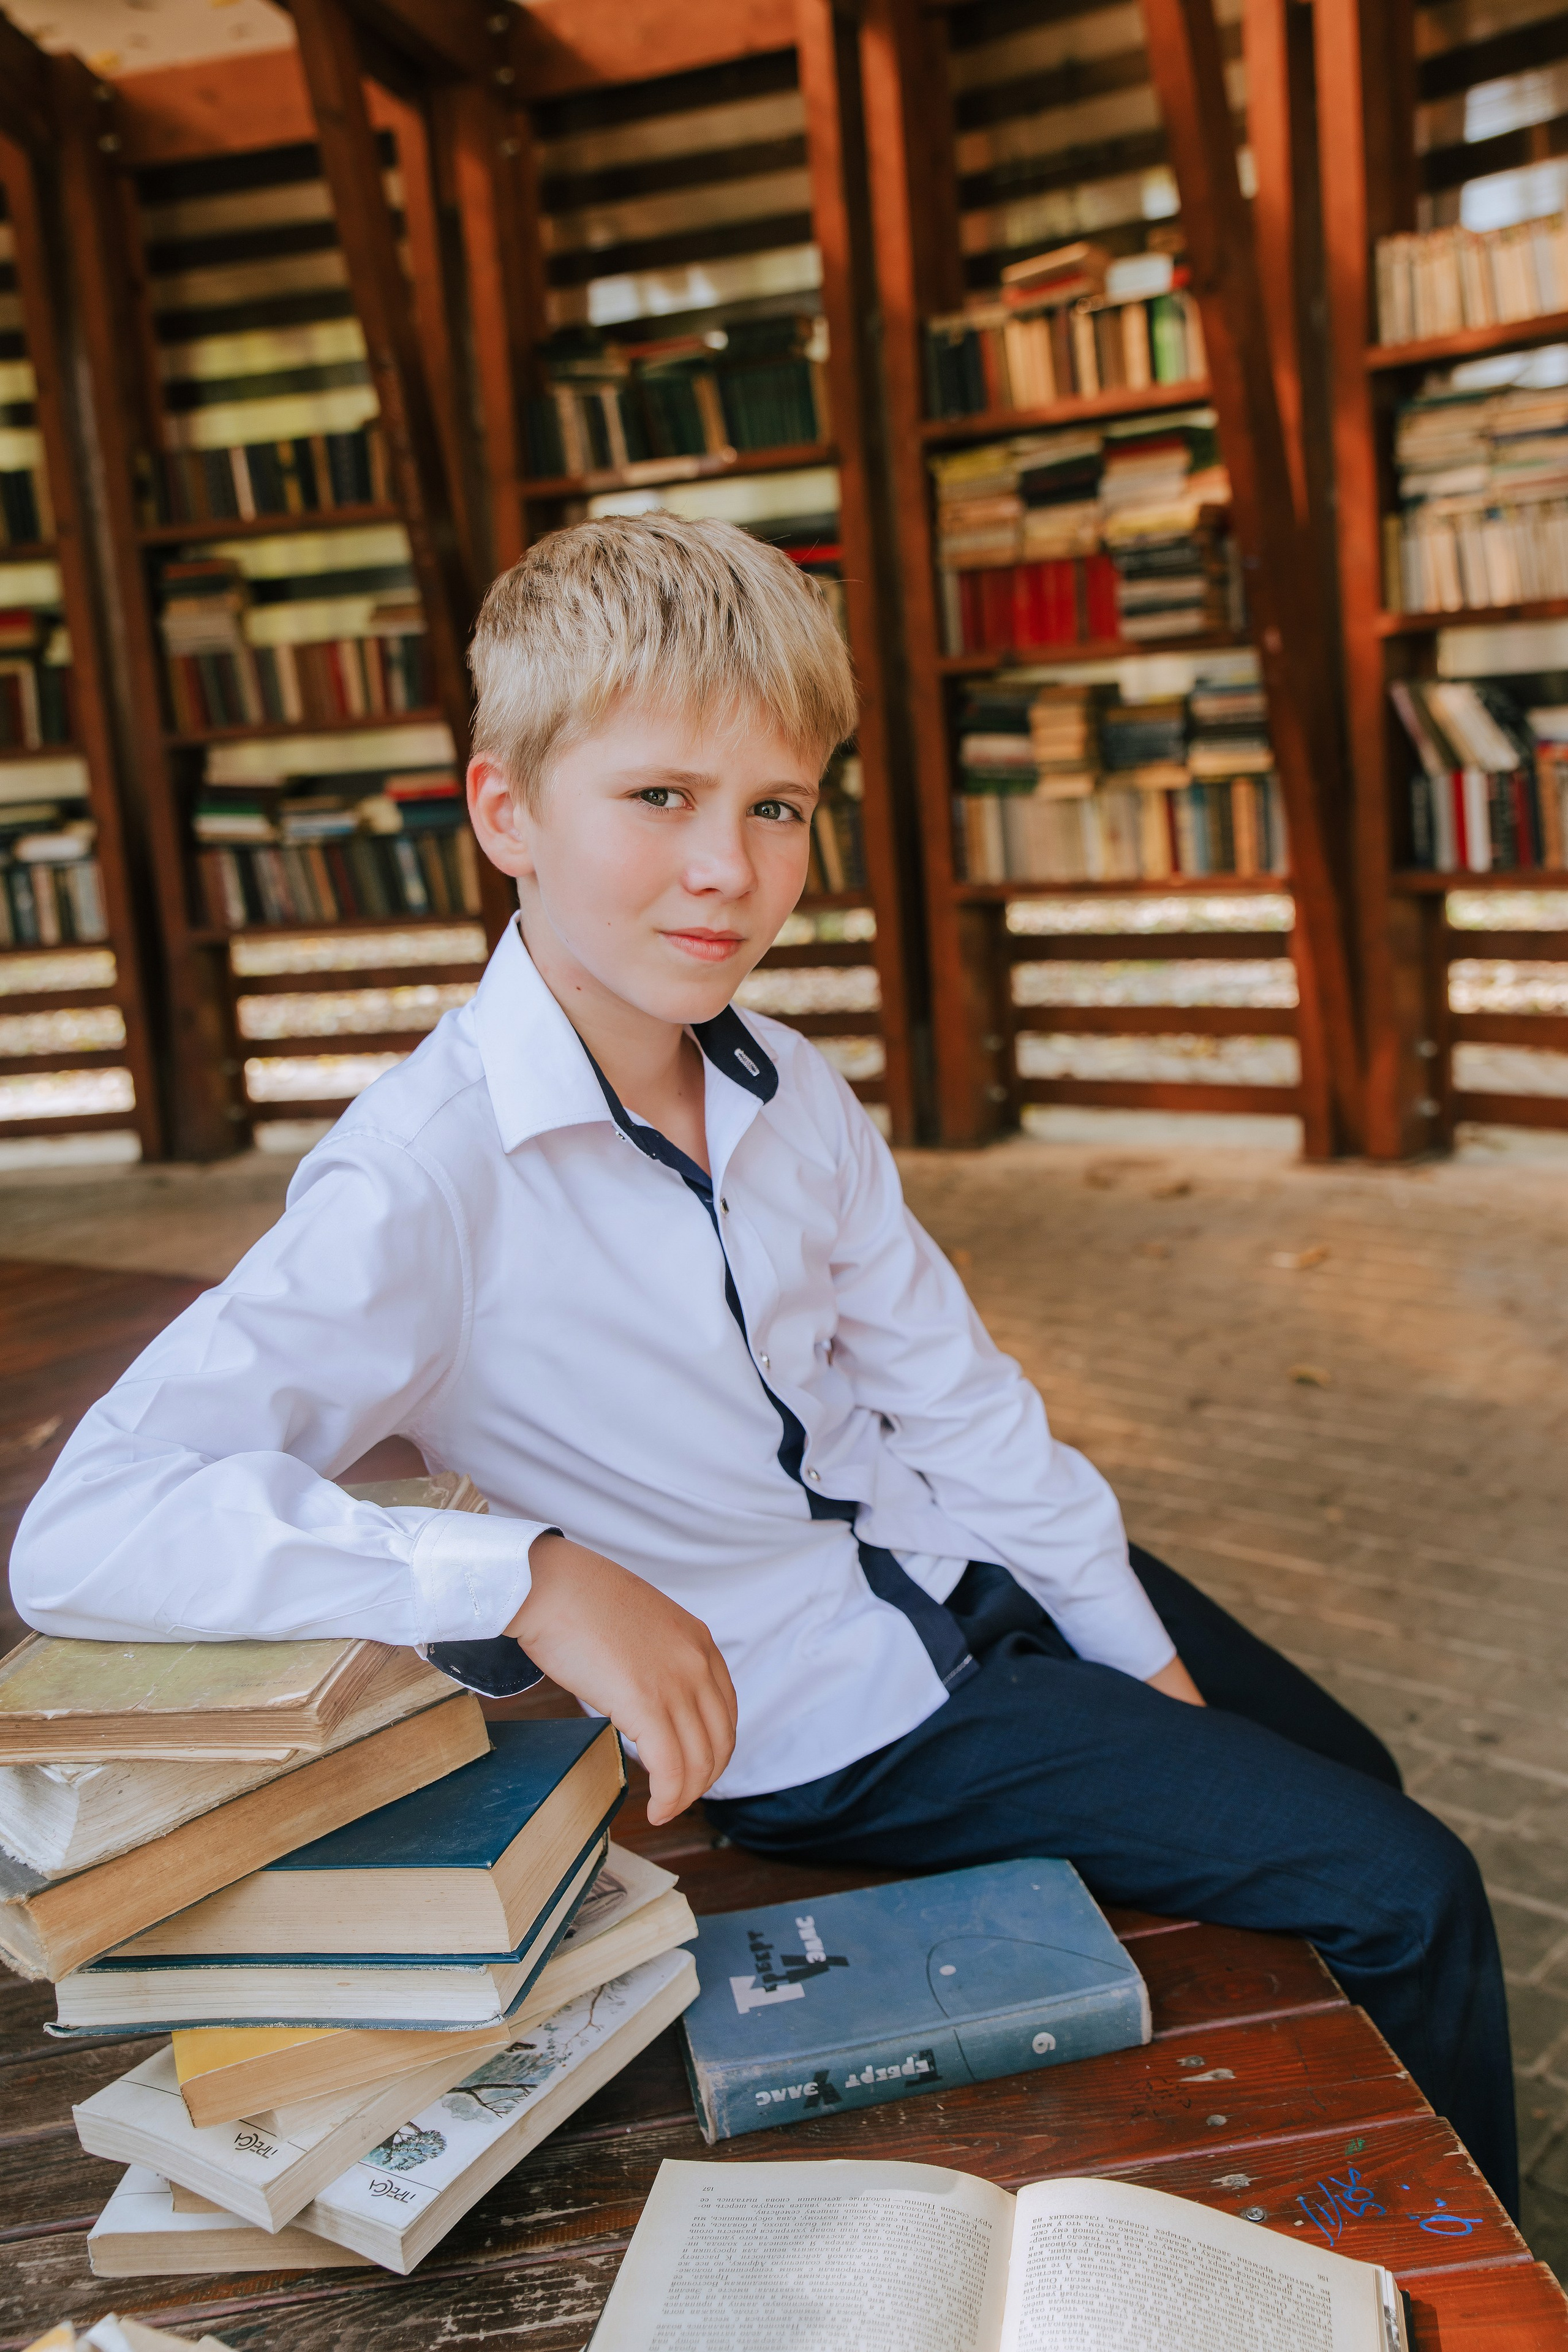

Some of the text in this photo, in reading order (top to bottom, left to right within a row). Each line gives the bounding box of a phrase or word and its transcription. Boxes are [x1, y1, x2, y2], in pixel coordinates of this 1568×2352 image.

[233, 2132, 279, 2160] ПРЕССА
[368, 2179, 417, 2204] ПРЕССА
[904, 2199, 935, 2210] Пиппы
[940, 2206, 970, 2218] сосков
[902, 2218, 946, 2231] пришлось
[960, 2218, 978, 2230] Как
[973, 2217, 992, 2230] круг
[1031, 2222, 1053, 2231] меня
[943, 2220, 991, 2242] зашлепали
[1072, 2228, 1120, 2237] доступной
[1118, 2226, 1149, 2237] только
[1155, 2228, 1192, 2244] четырех
[886, 2236, 926, 2247] горячего
[949, 2229, 990, 2250] гепардам
[956, 2238, 980, 2252] такой
[1039, 2240, 1077, 2248] буйвола
[1124, 2234, 1144, 2243] всей
[1153, 2235, 1188, 2249] жалела
[930, 2244, 959, 2257] чашка
[949, 2242, 967, 2255] Уму
[1082, 2241, 1111, 2250] морду
[1161, 2243, 1189, 2256] холму
[1197, 2242, 1231, 2258] заснять
[1027, 2254, 1071, 2264] пришлось
[1094, 2250, 1148, 2265] мгновенной
[1147, 2254, 1188, 2271] запустил
[1170, 2253, 1196, 2266] после
[1200, 2249, 1227, 2263] смеху
[963, 2255, 987, 2271] когда
[1153, 2263, 1180, 2275] такой
[1208, 2260, 1232, 2272] вверх
[1237, 2256, 1273, 2274] времени
[1184, 2272, 1215, 2288] видела
[1199, 2263, 1260, 2290] обстреливать
[1244, 2266, 1283, 2285] умирала
[1279, 2273, 1314, 2290] хватило
[1317, 2274, 1330, 2283] 156
[1237, 2270, 1292, 2296] припустился
[1188, 2281, 1244, 2305] присутствии
[1234, 2283, 1269, 2301] схватил
[1263, 2288, 1278, 2297] его
[1245, 2294, 1284, 2316] Никогда
[1274, 2299, 1287, 2310] Он
[1281, 2294, 1332, 2317] продолжал
[1305, 2297, 1332, 2310] нулся
[1260, 2308, 1317, 2335] подозревали
